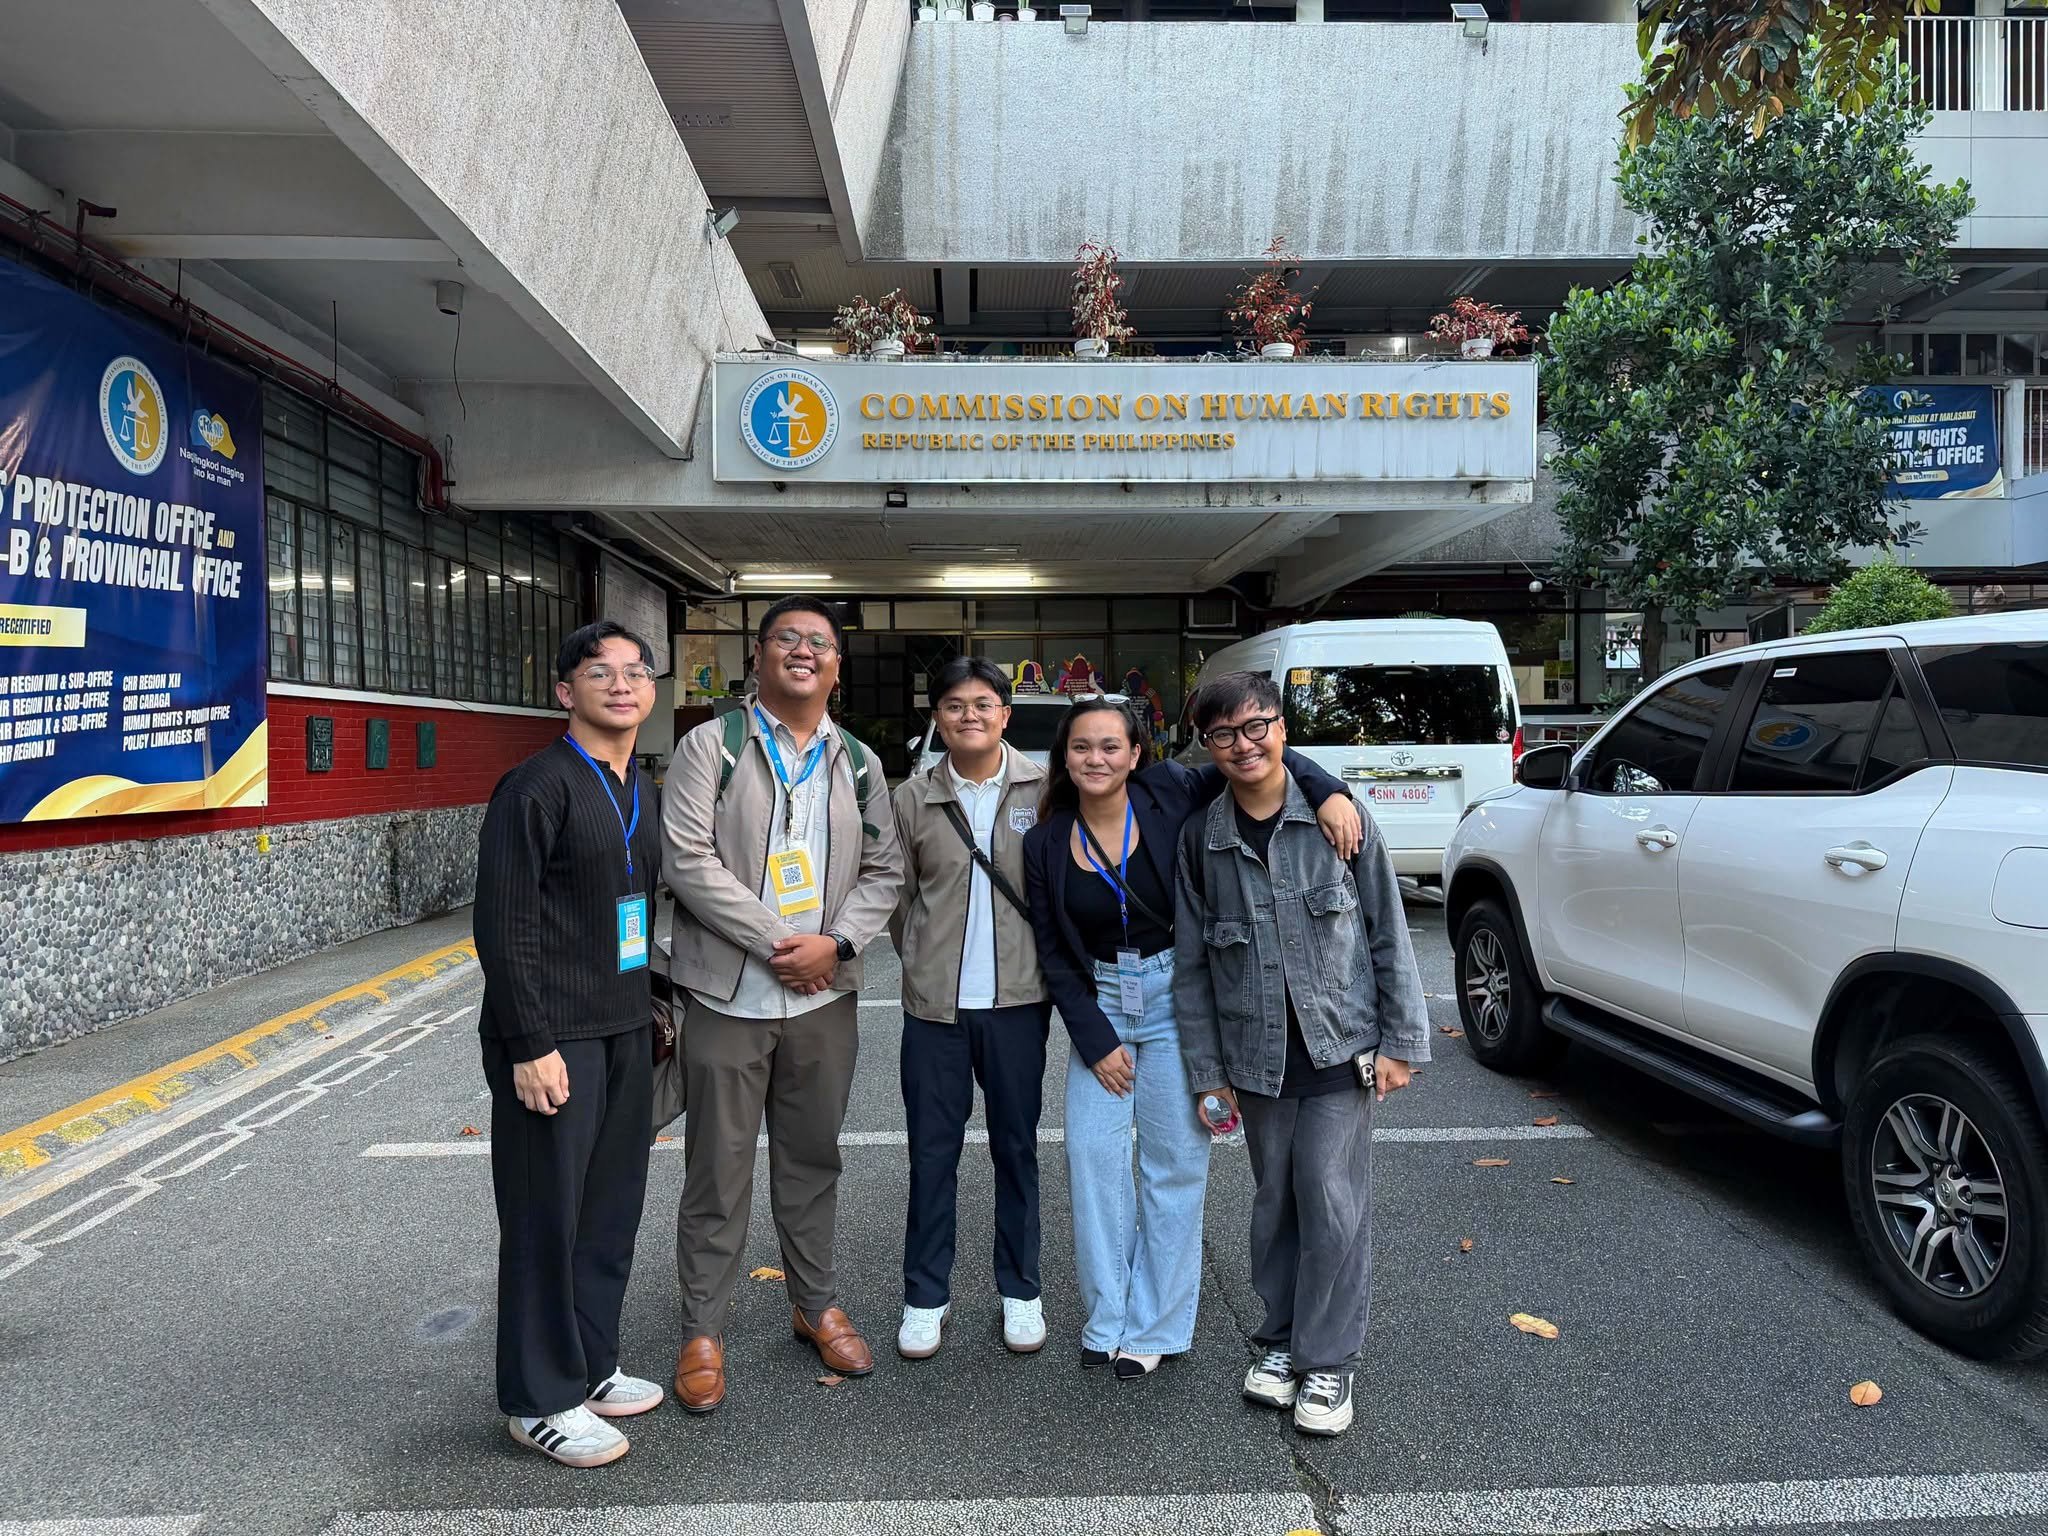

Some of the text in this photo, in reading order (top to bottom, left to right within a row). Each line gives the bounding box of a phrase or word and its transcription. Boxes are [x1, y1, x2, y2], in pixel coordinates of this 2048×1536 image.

[743, 375, 775, 416] COMMISSION
[791, 373, 818, 388] HUMAN
[818, 387, 835, 417] RIGHTS
[860, 392, 1511, 420] COMMISSION ON HUMAN RIGHTS
[743, 422, 769, 460] REPUBLIC
[799, 423, 835, 465] PHILIPPINES
[862, 432, 1236, 450] REPUBLIC OF THE PHILIPPINES
[1936, 445, 1985, 467] OFFICE
[12, 474, 151, 541] PROTECTION
[216, 529, 235, 549] AND
[34, 535, 52, 579] &
[60, 534, 184, 592] PROVINCIAL
[10, 675, 44, 694] REGION
[44, 673, 59, 691] VIII
[60, 674, 67, 690] &
[68, 670, 114, 689] SUB-OFFICE
[123, 672, 182, 692] CHR REGION XII
[12, 696, 43, 716] REGION
[44, 695, 54, 713] IX
[55, 697, 62, 712] &
[63, 691, 110, 711] SUB-OFFICE
[123, 692, 170, 711] CHR CARAGA
[210, 705, 231, 721] OFFICE
[14, 719, 43, 739] REGION
[45, 717, 52, 735] X
[53, 718, 60, 734] &
[61, 712, 108, 733] SUB-OFFICE
[123, 713, 150, 732] HUMAN
[152, 711, 183, 728] RIGHTS
[13, 740, 44, 762] REGION
[45, 739, 55, 757] XI
[123, 733, 149, 752] POLICY
[150, 729, 192, 748] LINKAGES
[1376, 789, 1395, 800] SNN
[1402, 788, 1427, 800] 4806
